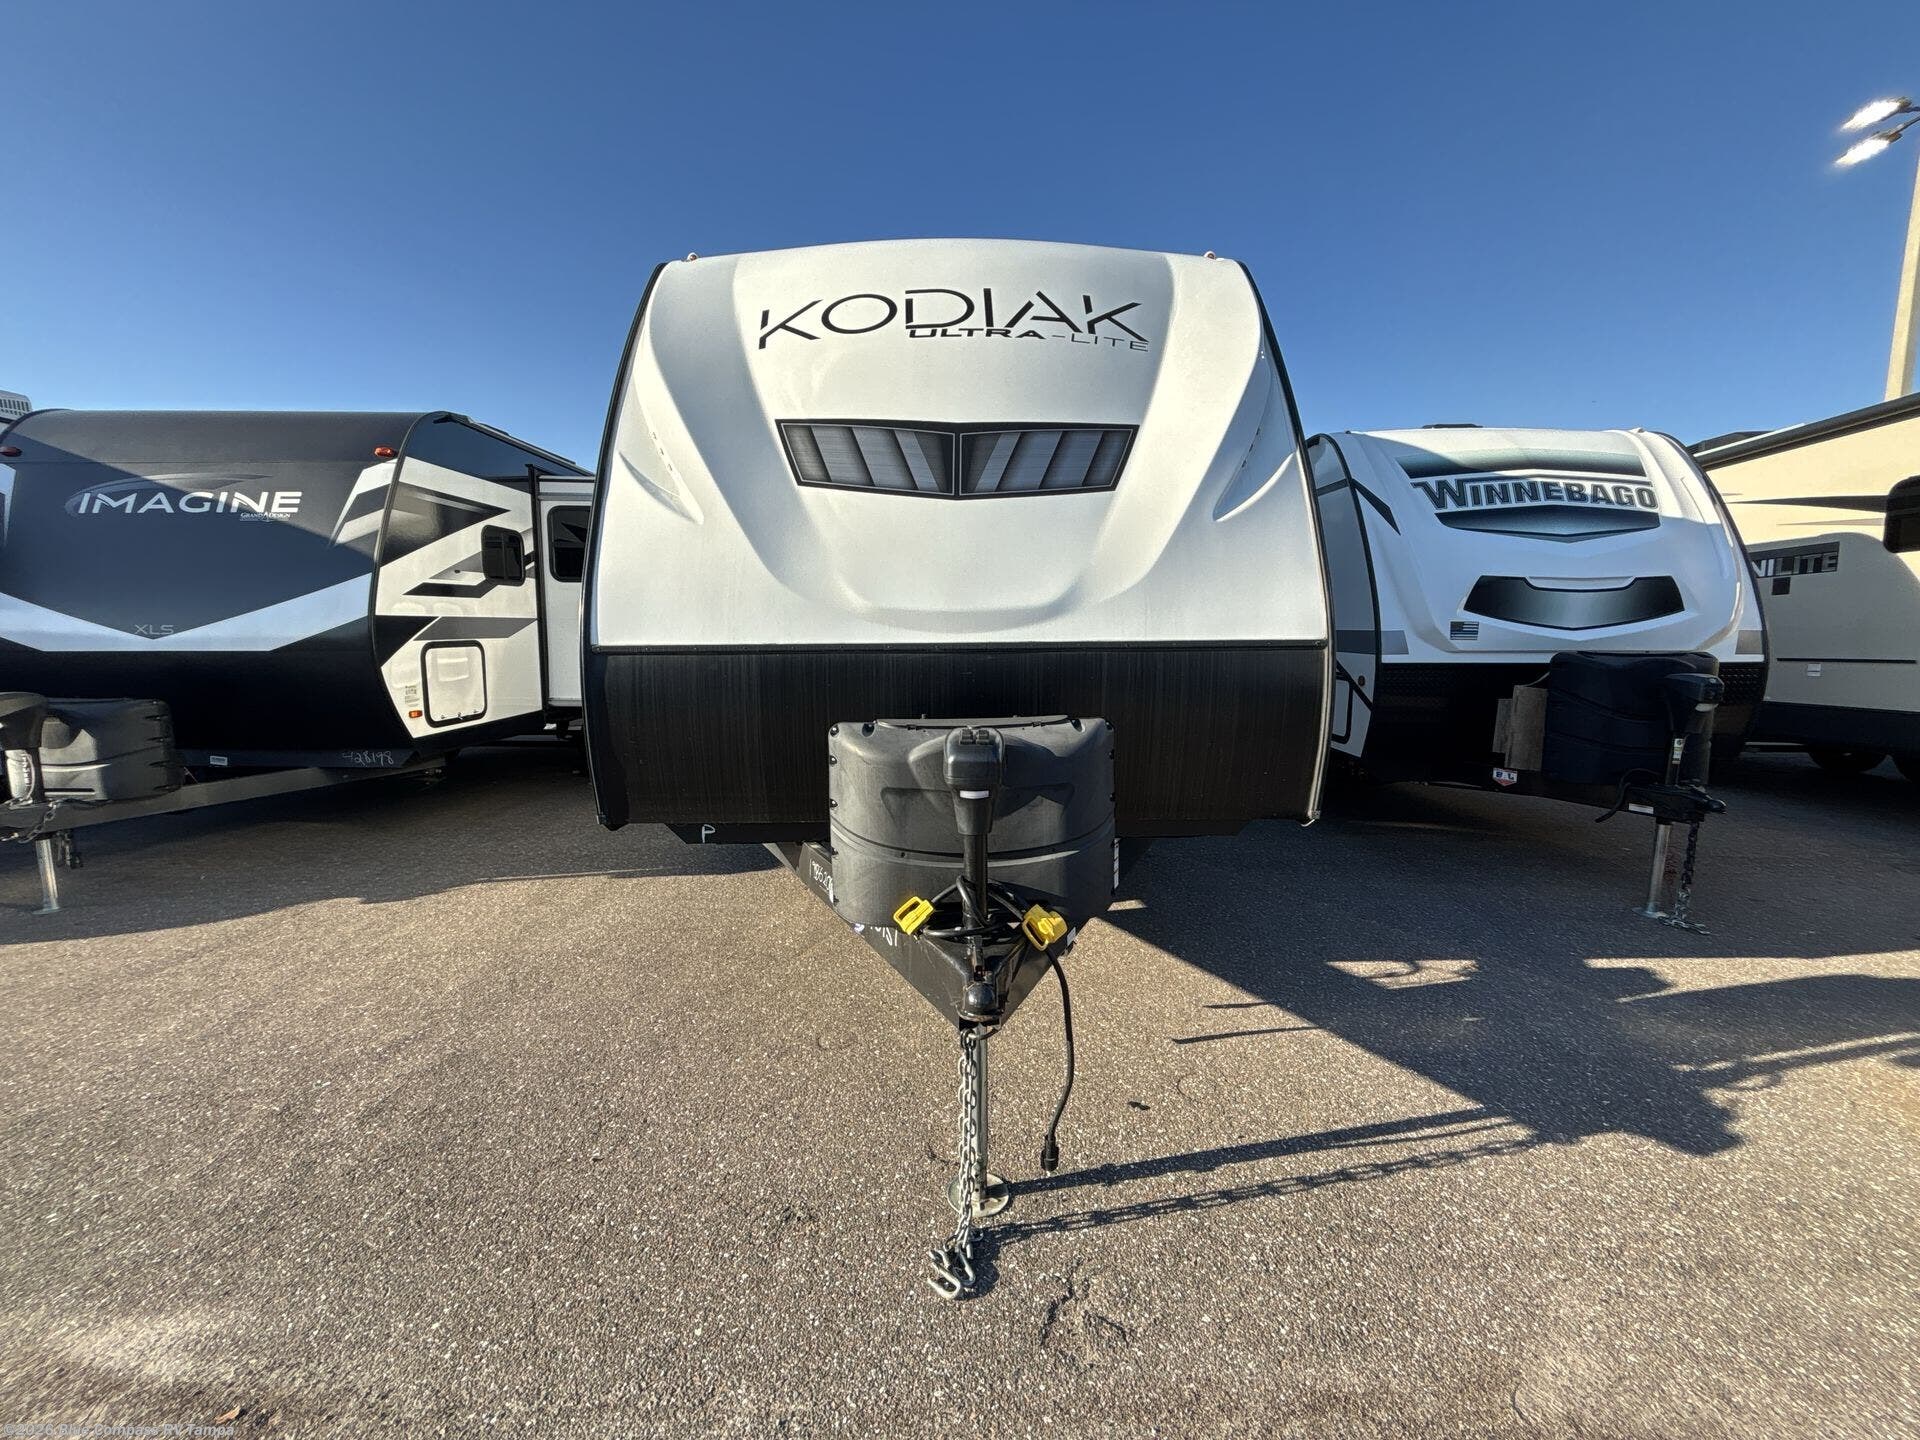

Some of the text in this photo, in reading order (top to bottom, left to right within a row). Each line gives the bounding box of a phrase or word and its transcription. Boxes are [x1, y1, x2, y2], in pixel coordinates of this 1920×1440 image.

[758, 288, 1149, 350] KODIAK
[909, 327, 1149, 352] ULTRA-LITE
[78, 491, 303, 514] IMAGINE
[1411, 479, 1659, 509] WINNEBAGO
[134, 624, 174, 635] XLS
[701, 824, 716, 843] P
